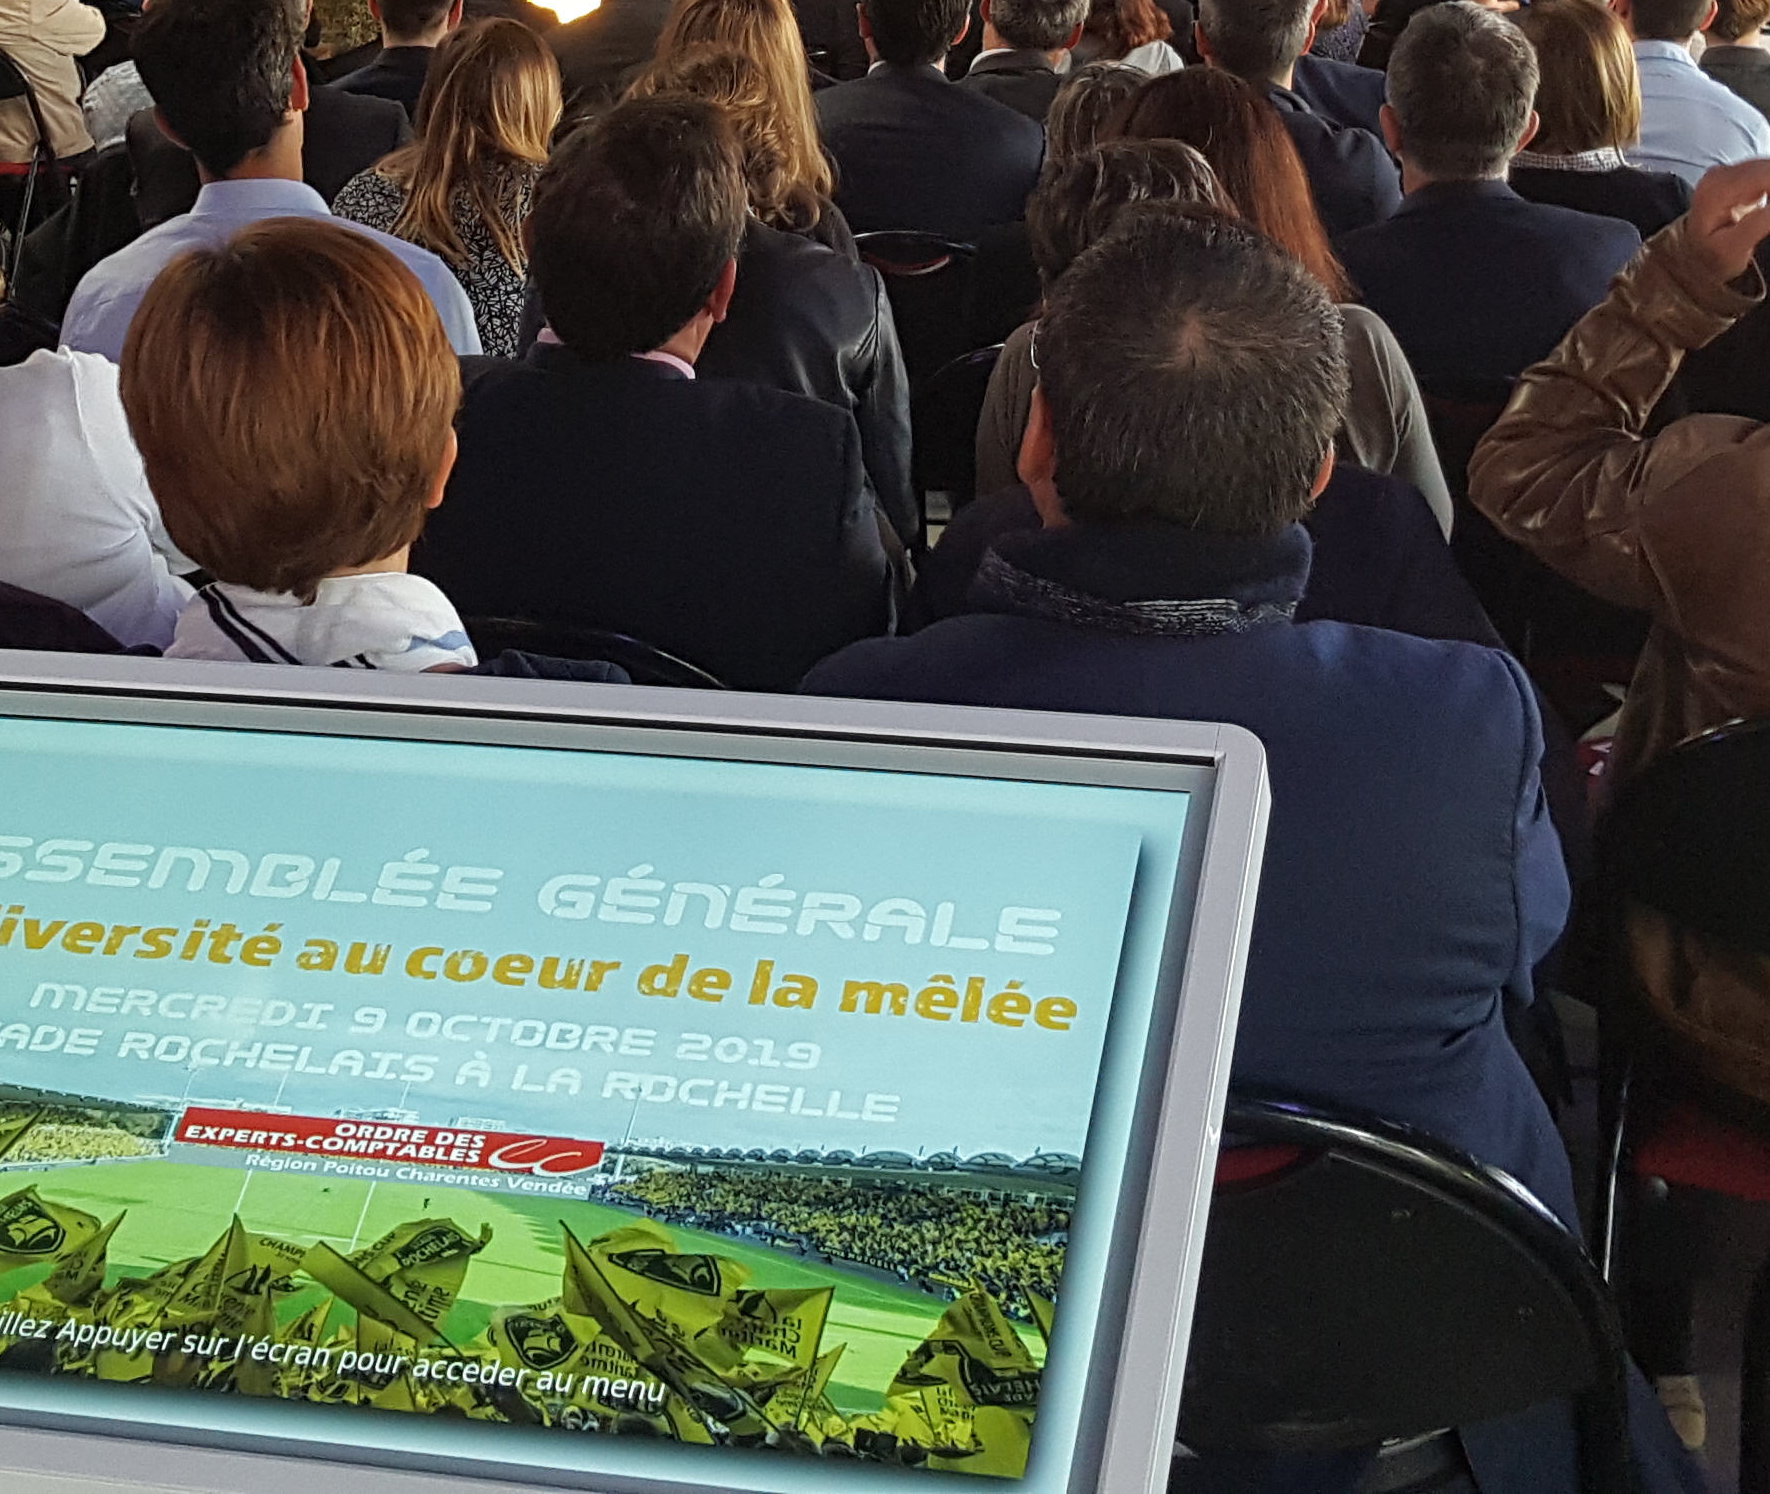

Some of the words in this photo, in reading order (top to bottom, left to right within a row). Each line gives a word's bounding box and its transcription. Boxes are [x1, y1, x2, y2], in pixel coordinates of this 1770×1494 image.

[536, 864, 1062, 955] GÉNÉRALE
[29, 982, 333, 1031] MERCREDI
[350, 1005, 389, 1035] 9
[405, 1008, 659, 1055] OCTOBRE
[674, 1032, 823, 1070] 2019
[296, 938, 392, 975] au
[405, 945, 622, 993] coeur
[636, 954, 733, 1003] de
[748, 958, 819, 1010] la
[838, 973, 1078, 1032] mêlée
[118, 1031, 435, 1083] ROCHELAIS
[454, 1051, 492, 1086] À
[510, 1063, 583, 1095] LA
[601, 1070, 904, 1124] ROCHELLE
[184, 1124, 482, 1164] EXPERTS-COMPTABLES
[245, 1153, 317, 1175] Région
[323, 1160, 390, 1179] Poitou
[395, 1165, 500, 1188] Charentes
[506, 1175, 587, 1197] Vendée
[334, 1121, 426, 1144] ORDRE
[434, 1131, 486, 1149] DES
[55, 1316, 177, 1354] Appuyer
[180, 1334, 230, 1355] sur
[234, 1335, 331, 1367] l'écran
[337, 1351, 407, 1374] pour
[412, 1356, 531, 1389] acceder
[536, 1370, 573, 1393] au
[582, 1374, 666, 1402] menu
